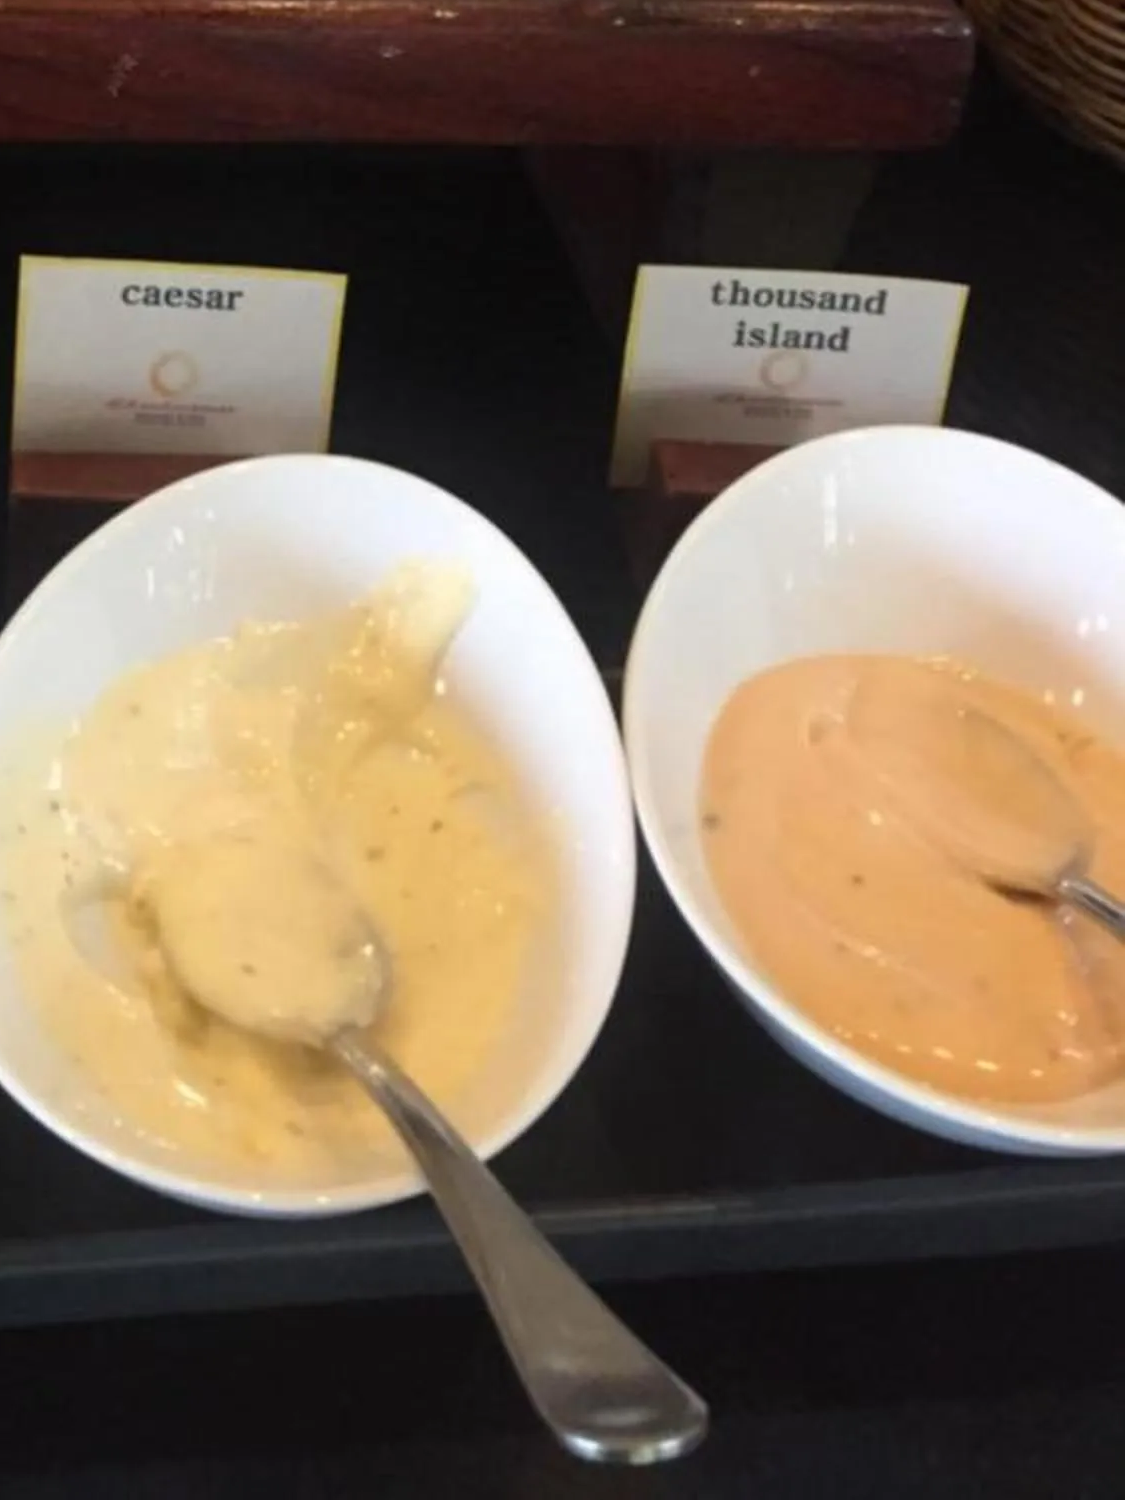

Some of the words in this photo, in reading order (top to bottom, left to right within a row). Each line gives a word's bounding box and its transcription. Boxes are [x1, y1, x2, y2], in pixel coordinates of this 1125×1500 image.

[121, 283, 244, 311] caesar
[711, 280, 888, 315] thousand
[733, 321, 851, 352] island
